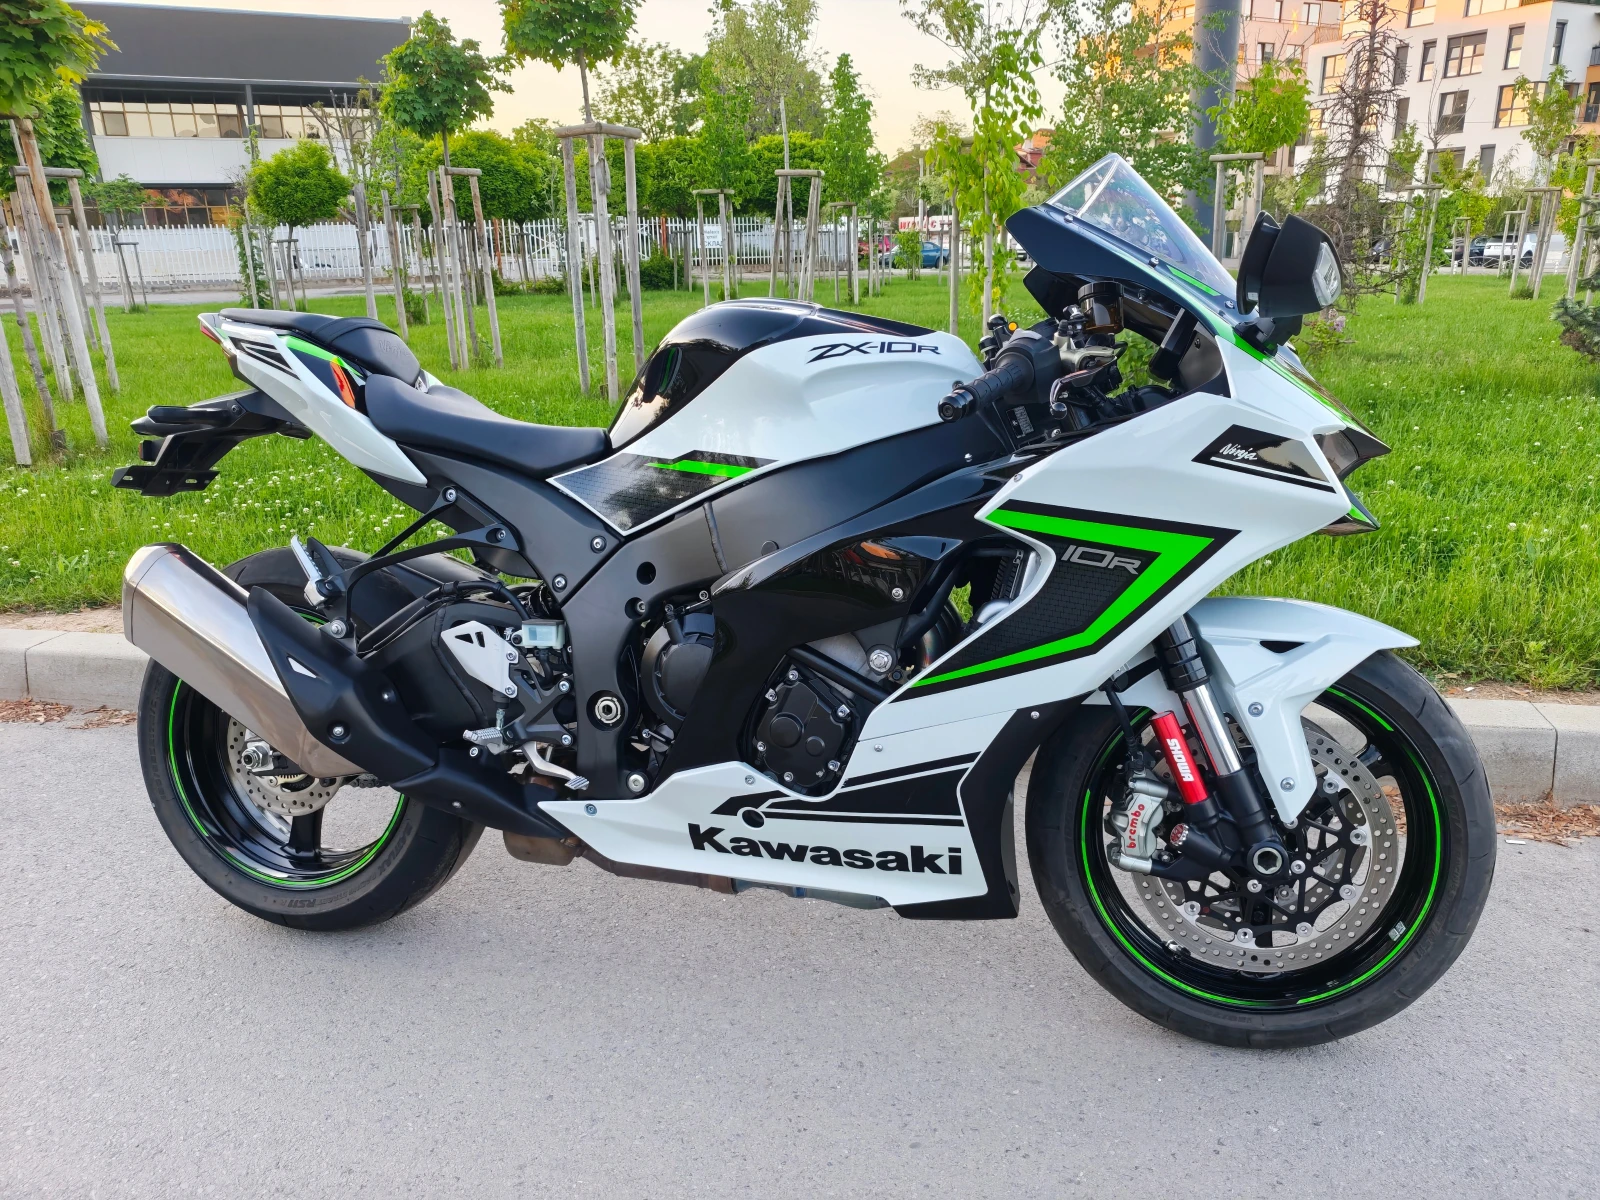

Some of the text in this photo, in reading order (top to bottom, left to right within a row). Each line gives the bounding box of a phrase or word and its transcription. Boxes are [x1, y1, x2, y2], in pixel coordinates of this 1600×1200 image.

[805, 341, 942, 364] ZX-10R
[1219, 443, 1257, 460] Ninja
[1060, 544, 1141, 575] 10R
[1166, 738, 1195, 782] SHOWA
[1126, 803, 1145, 849] brembo
[687, 823, 962, 875] Kawasaki
